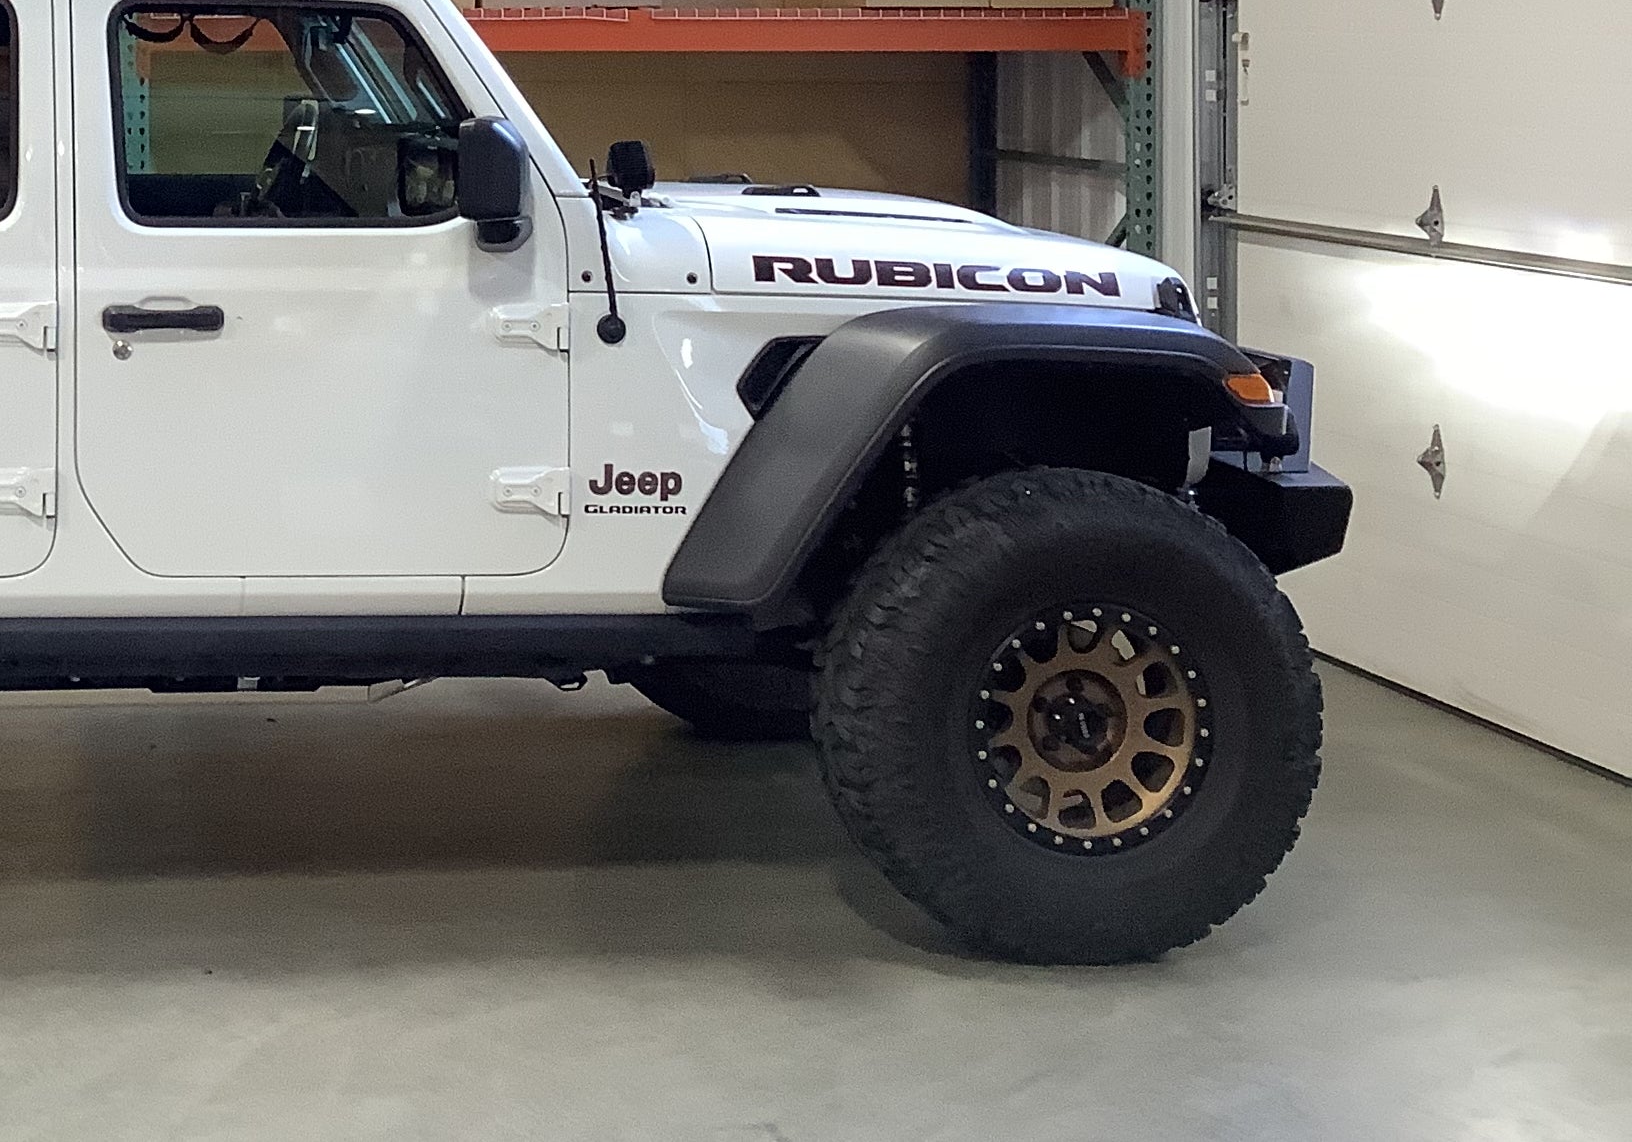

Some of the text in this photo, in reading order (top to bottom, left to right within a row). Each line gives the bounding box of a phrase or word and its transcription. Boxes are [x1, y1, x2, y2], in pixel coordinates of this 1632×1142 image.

[753, 255, 1120, 297] RUBICON
[589, 463, 682, 501] Jeep
[584, 504, 687, 515] GLADIATOR
